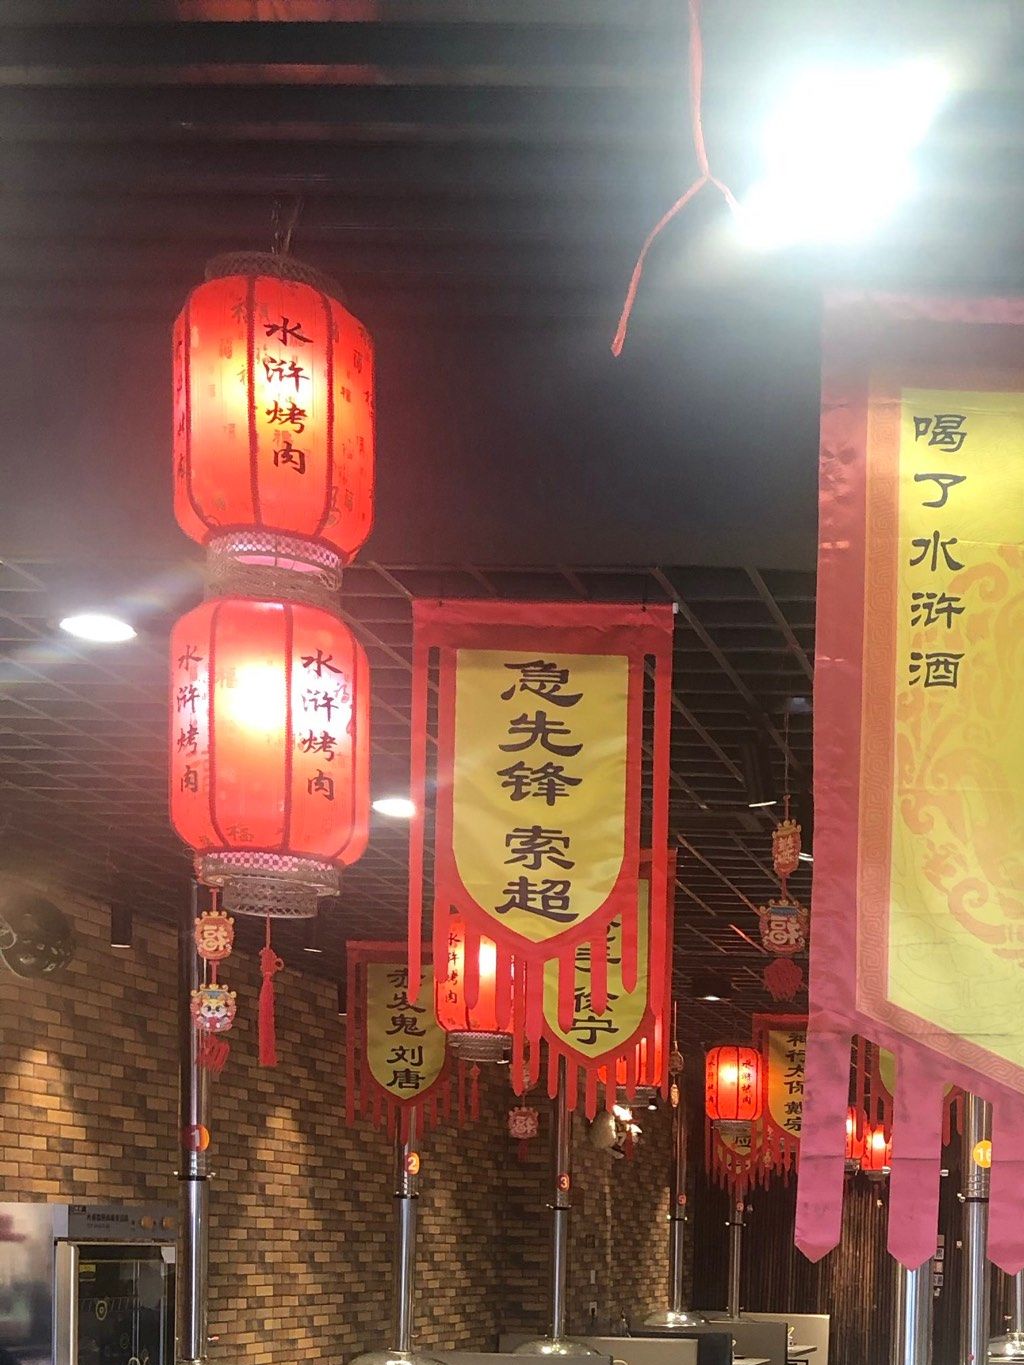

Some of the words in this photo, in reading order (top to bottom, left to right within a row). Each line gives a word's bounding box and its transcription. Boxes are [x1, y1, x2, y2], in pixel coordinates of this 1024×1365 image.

[264, 316, 314, 475] 水浒烤肉
[908, 413, 966, 691] 喝了水浒酒
[177, 645, 204, 793] 水浒烤肉
[300, 649, 343, 802] 水浒烤肉
[494, 659, 585, 923] 急先锋索超
[190, 1129, 201, 1147] 1
[407, 1156, 417, 1171] 2
[560, 1176, 567, 1188] 3
